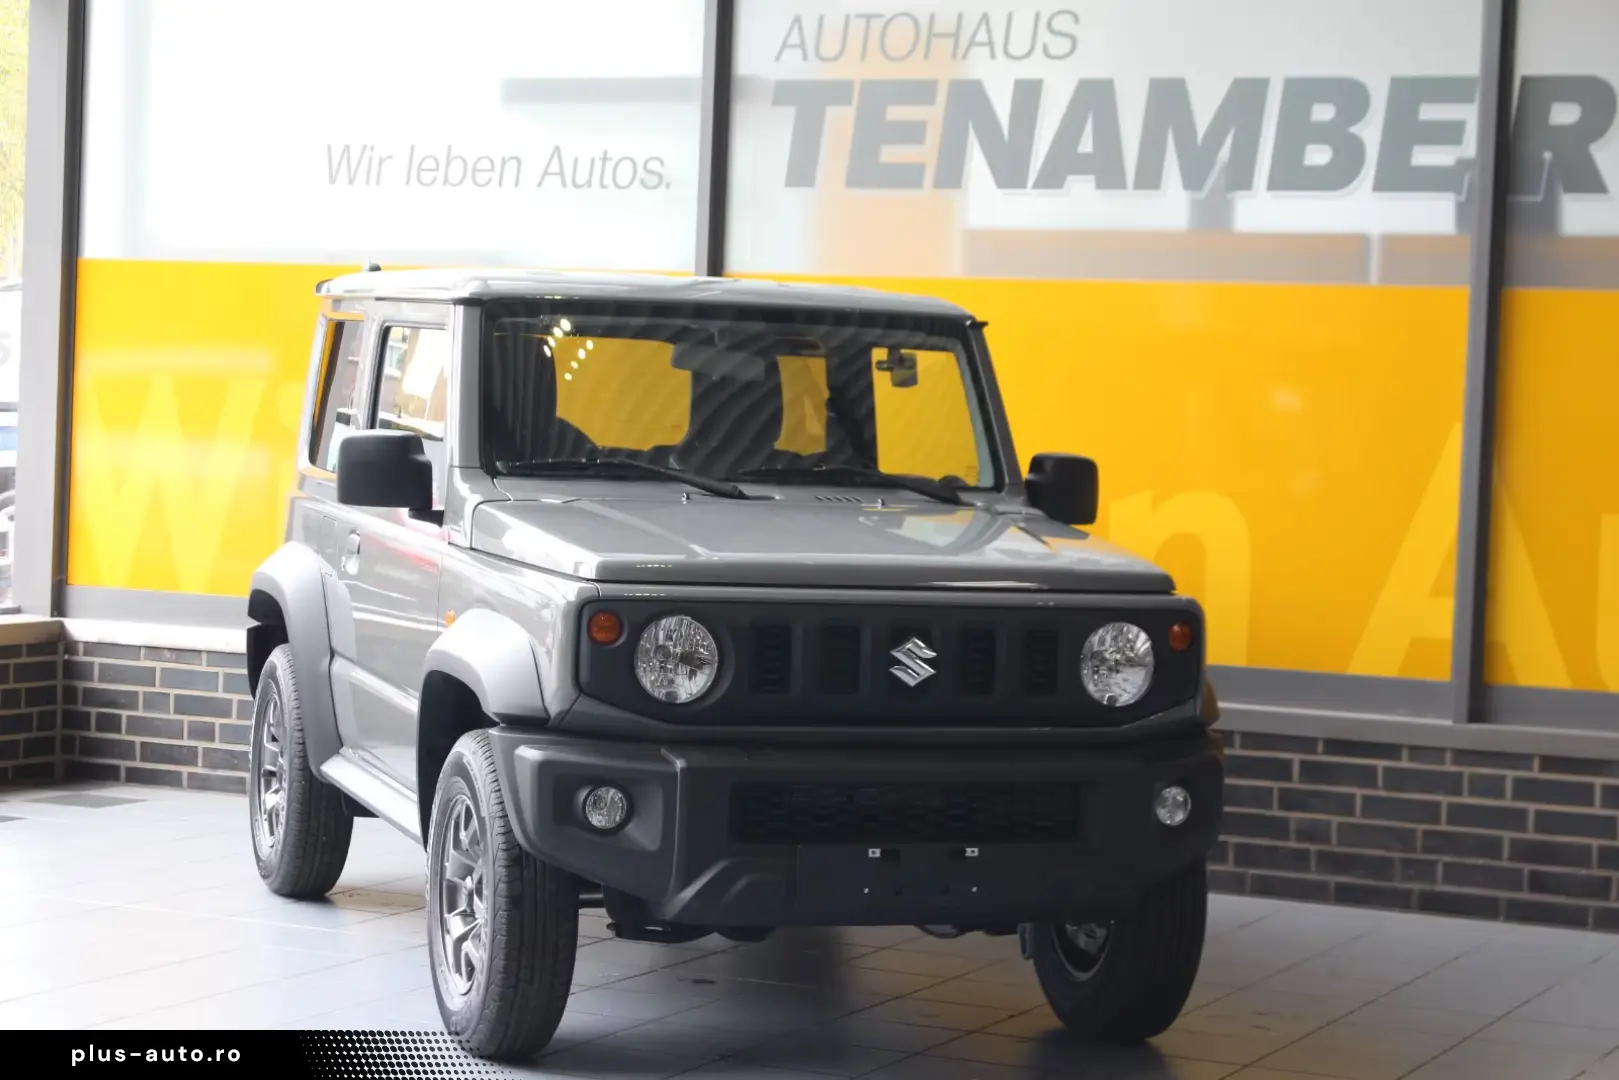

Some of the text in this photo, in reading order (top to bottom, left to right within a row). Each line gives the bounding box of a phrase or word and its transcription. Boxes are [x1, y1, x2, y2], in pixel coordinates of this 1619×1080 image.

[774, 10, 1080, 62] AUTOHAUS
[771, 75, 1617, 194] TENAMBER
[327, 143, 672, 190] Wir leben Autos.
